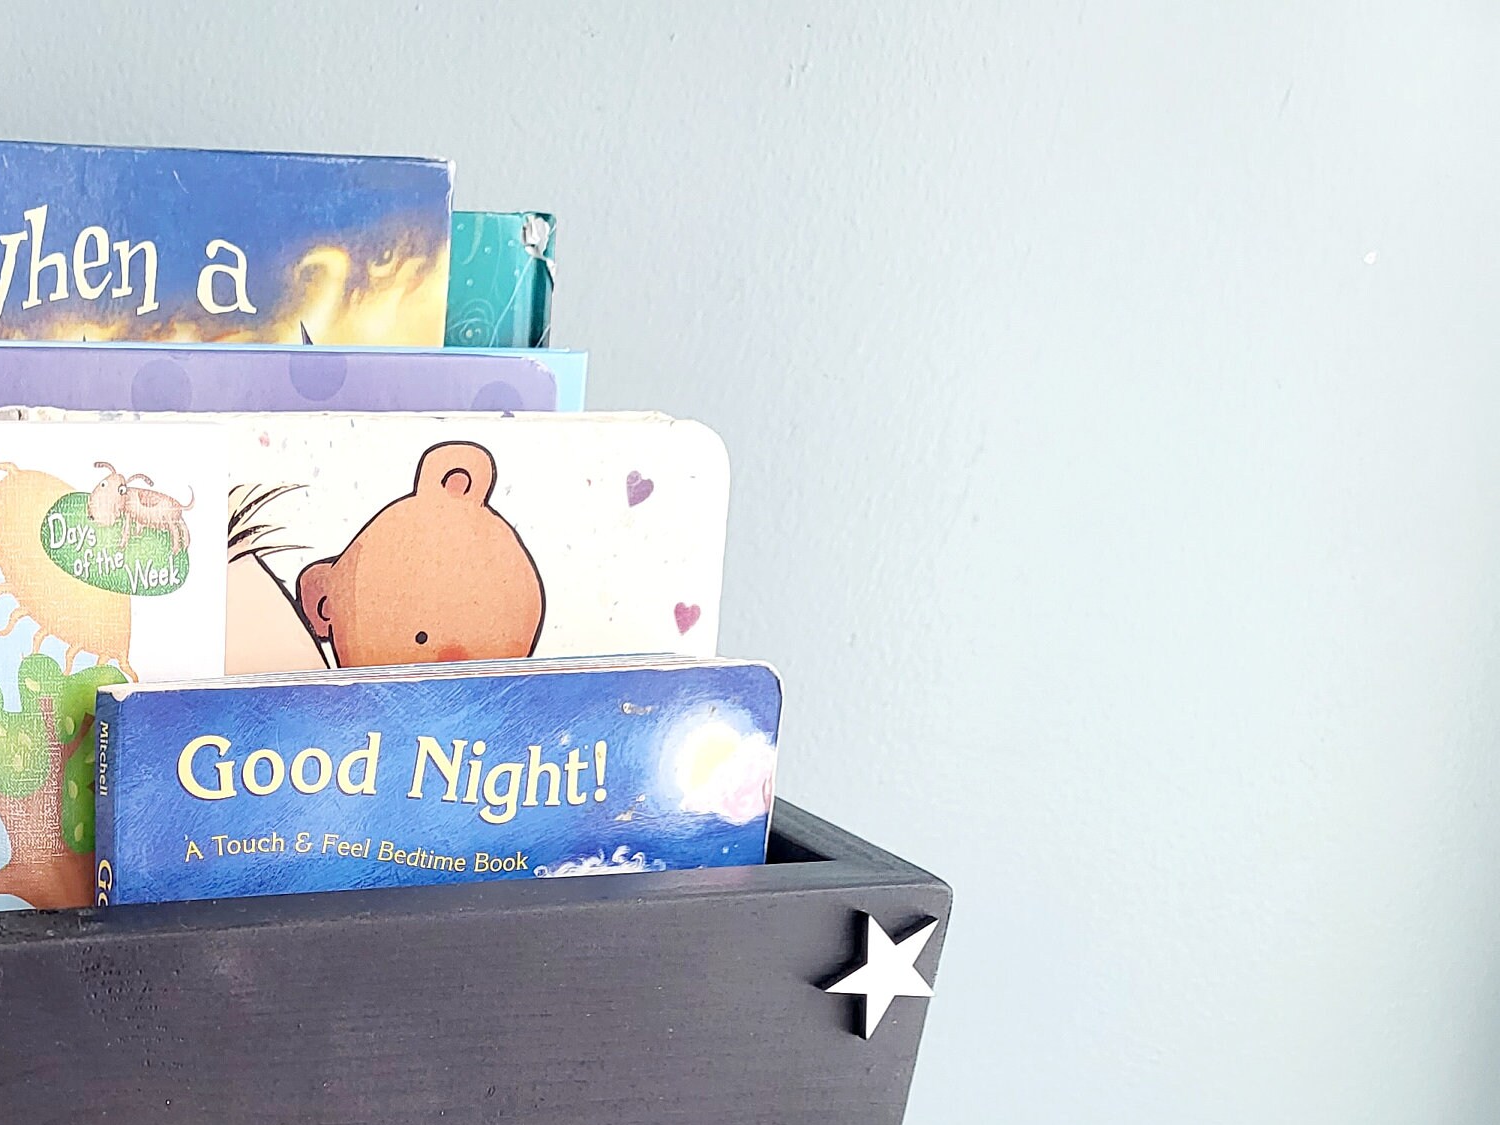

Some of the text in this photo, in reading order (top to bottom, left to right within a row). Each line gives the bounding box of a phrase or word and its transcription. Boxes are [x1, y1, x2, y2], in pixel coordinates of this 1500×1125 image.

[196, 238, 258, 315] a
[47, 512, 98, 551] Days
[73, 549, 125, 579] of the
[125, 554, 181, 594] Week
[99, 720, 110, 797] Mitchell
[176, 731, 609, 825] Good Night!
[184, 831, 530, 873] A Touch & Feel Bedtime Book
